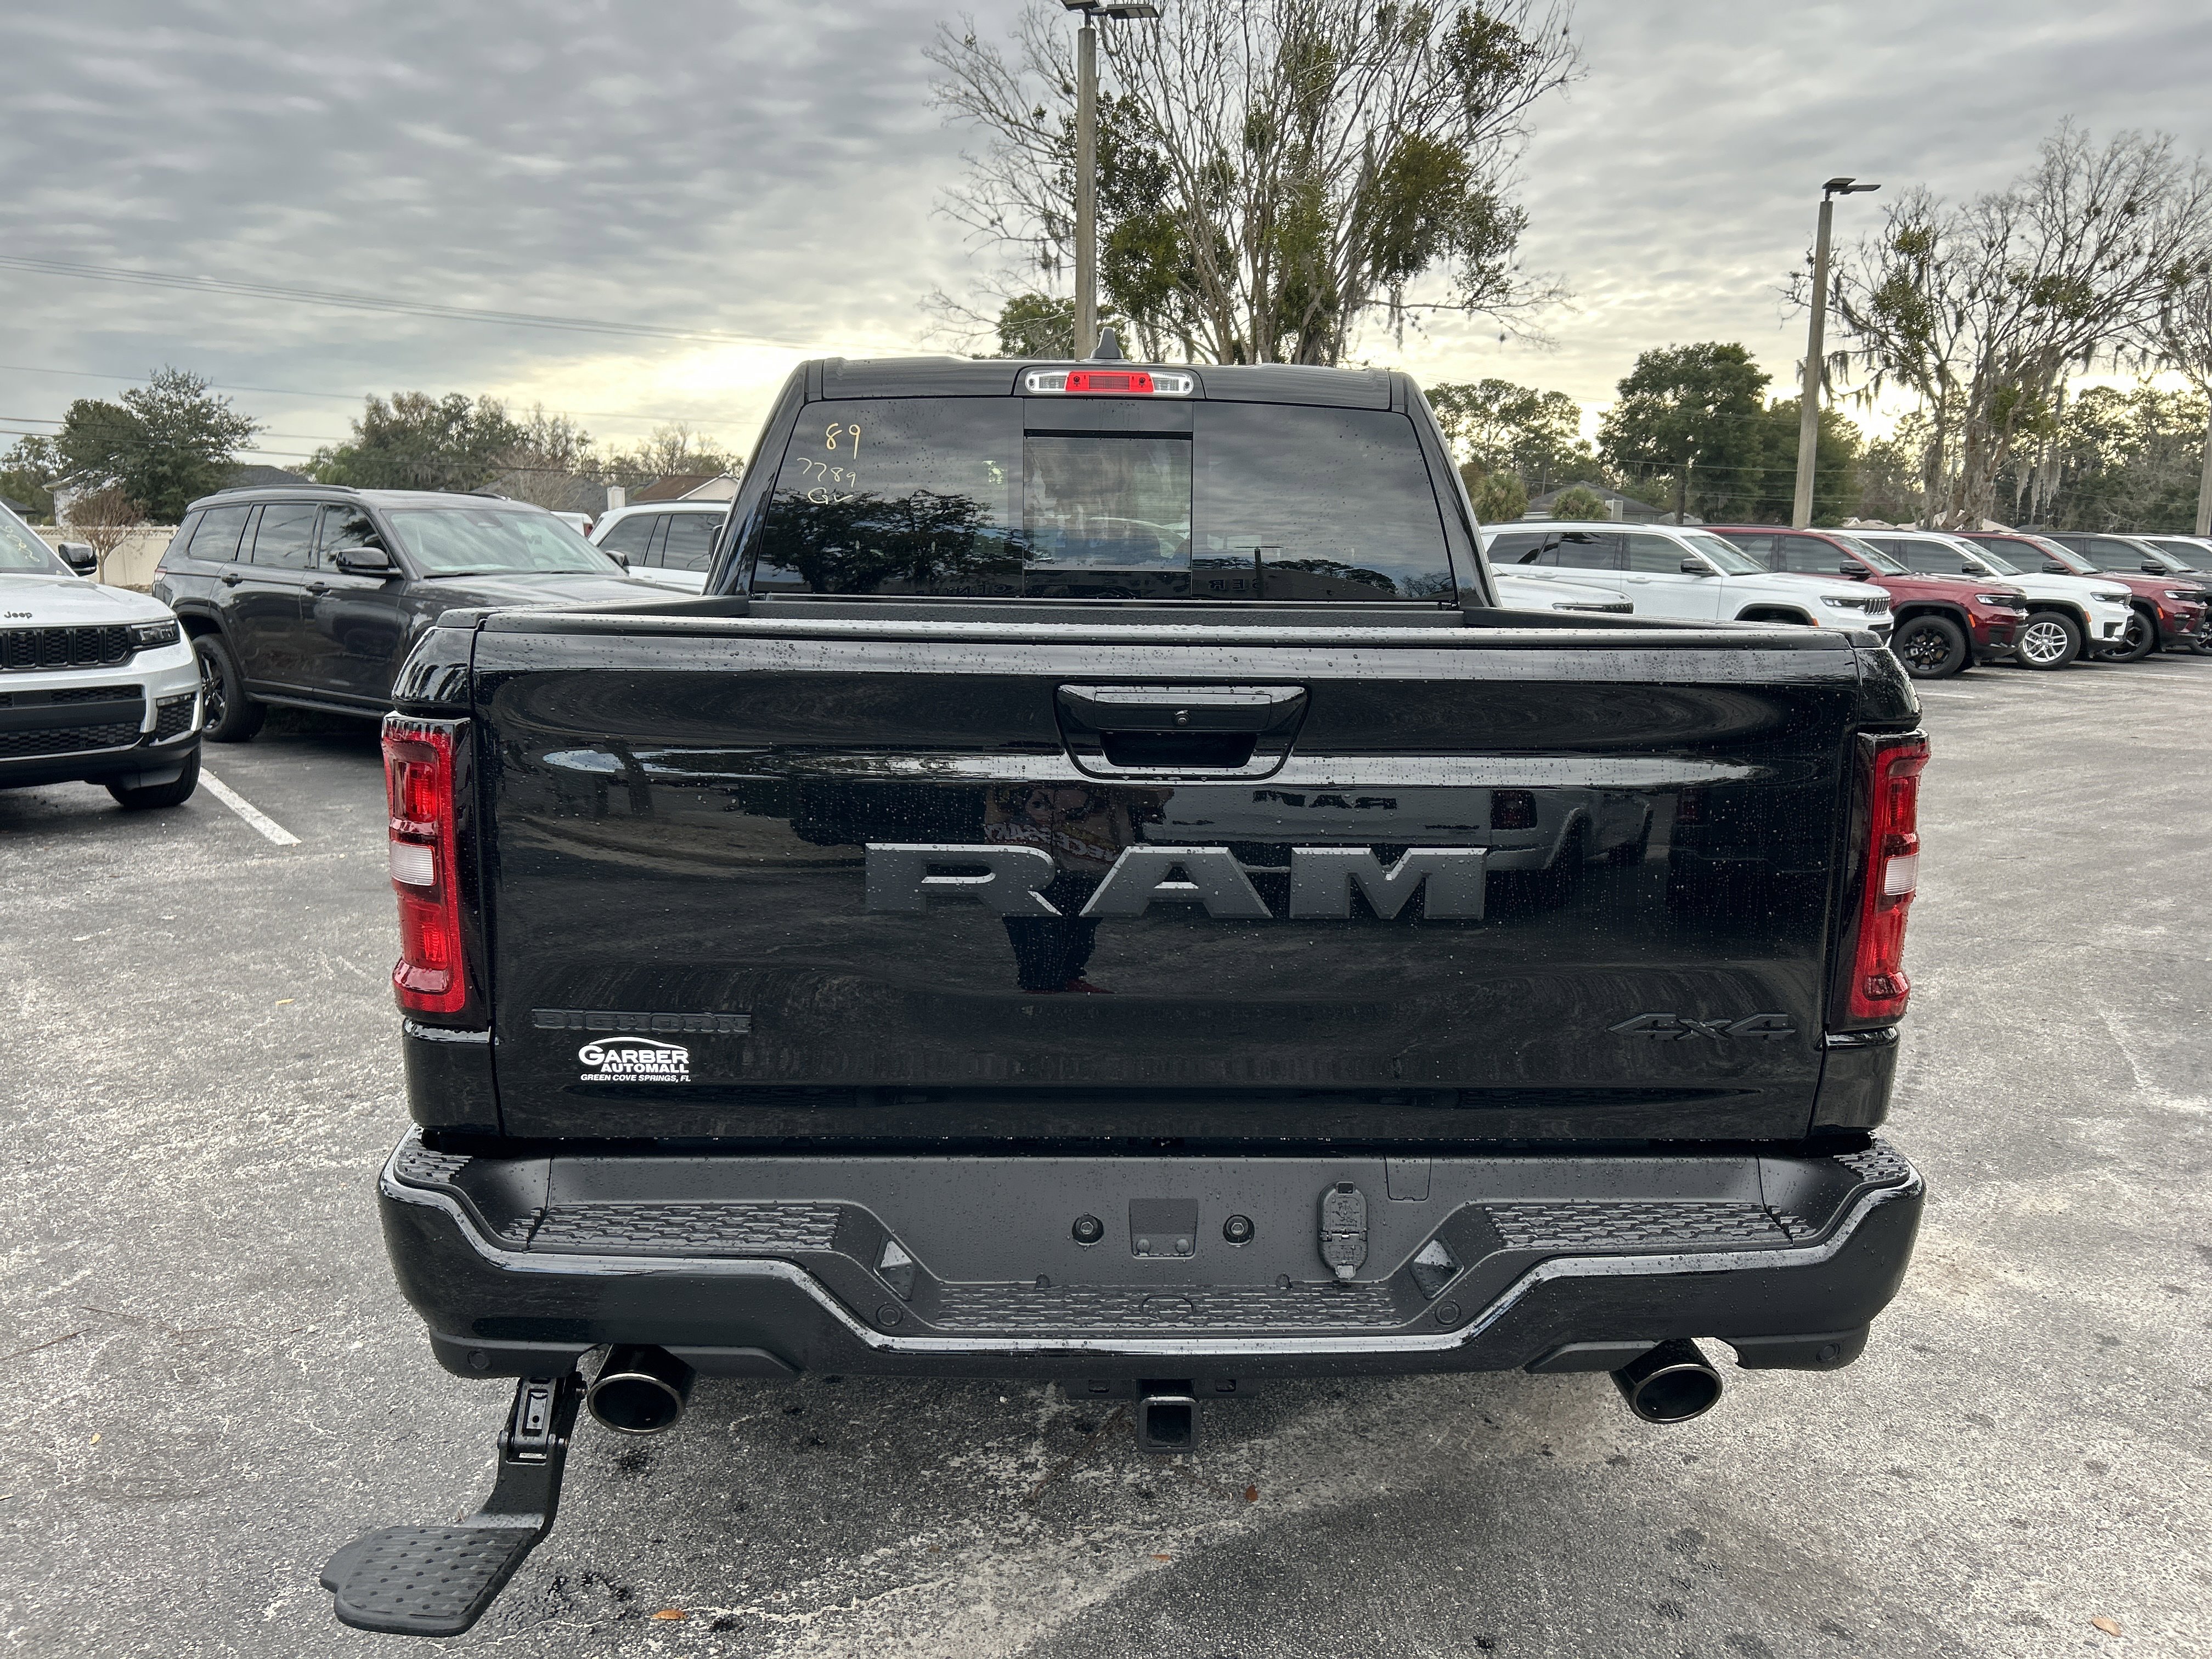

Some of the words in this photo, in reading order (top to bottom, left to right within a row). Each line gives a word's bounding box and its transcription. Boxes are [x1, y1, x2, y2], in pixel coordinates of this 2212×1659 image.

[826, 422, 861, 460] 89
[797, 457, 856, 488] 7789
[865, 842, 1488, 919] RAM
[578, 1045, 690, 1065] GARBER
[600, 1063, 690, 1073] AUTOMALL
[638, 1074, 679, 1082] SPRINGS,
